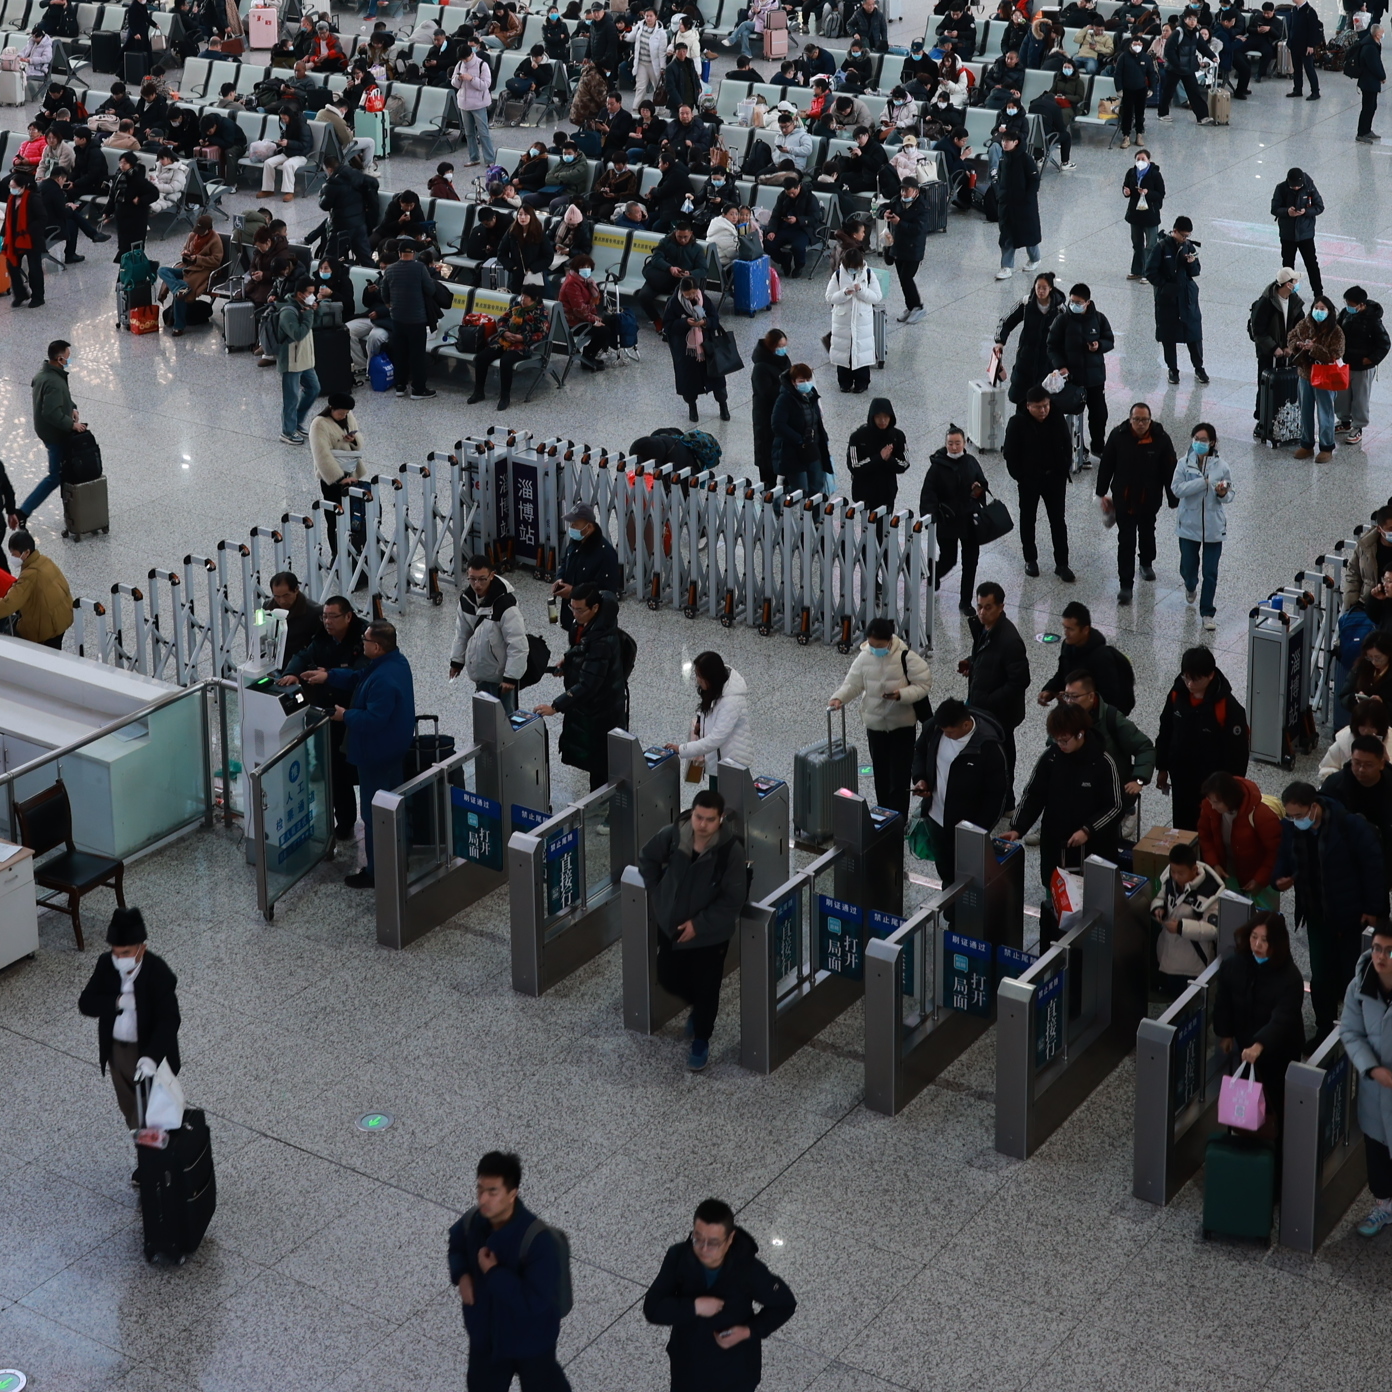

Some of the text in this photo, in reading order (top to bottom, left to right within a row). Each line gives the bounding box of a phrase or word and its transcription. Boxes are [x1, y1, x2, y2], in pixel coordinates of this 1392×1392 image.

[517, 477, 535, 546] 淄博站
[1289, 648, 1300, 727] 淄博站
[463, 794, 490, 809] 刷证通过
[467, 831, 480, 860] 局面
[479, 827, 491, 856] 打开
[825, 897, 858, 915] 刷证通过
[827, 938, 842, 973] 局面
[844, 935, 858, 968] 打开
[951, 934, 987, 953] 刷证通过
[953, 976, 968, 1011] 局面
[970, 972, 987, 1007] 打开
